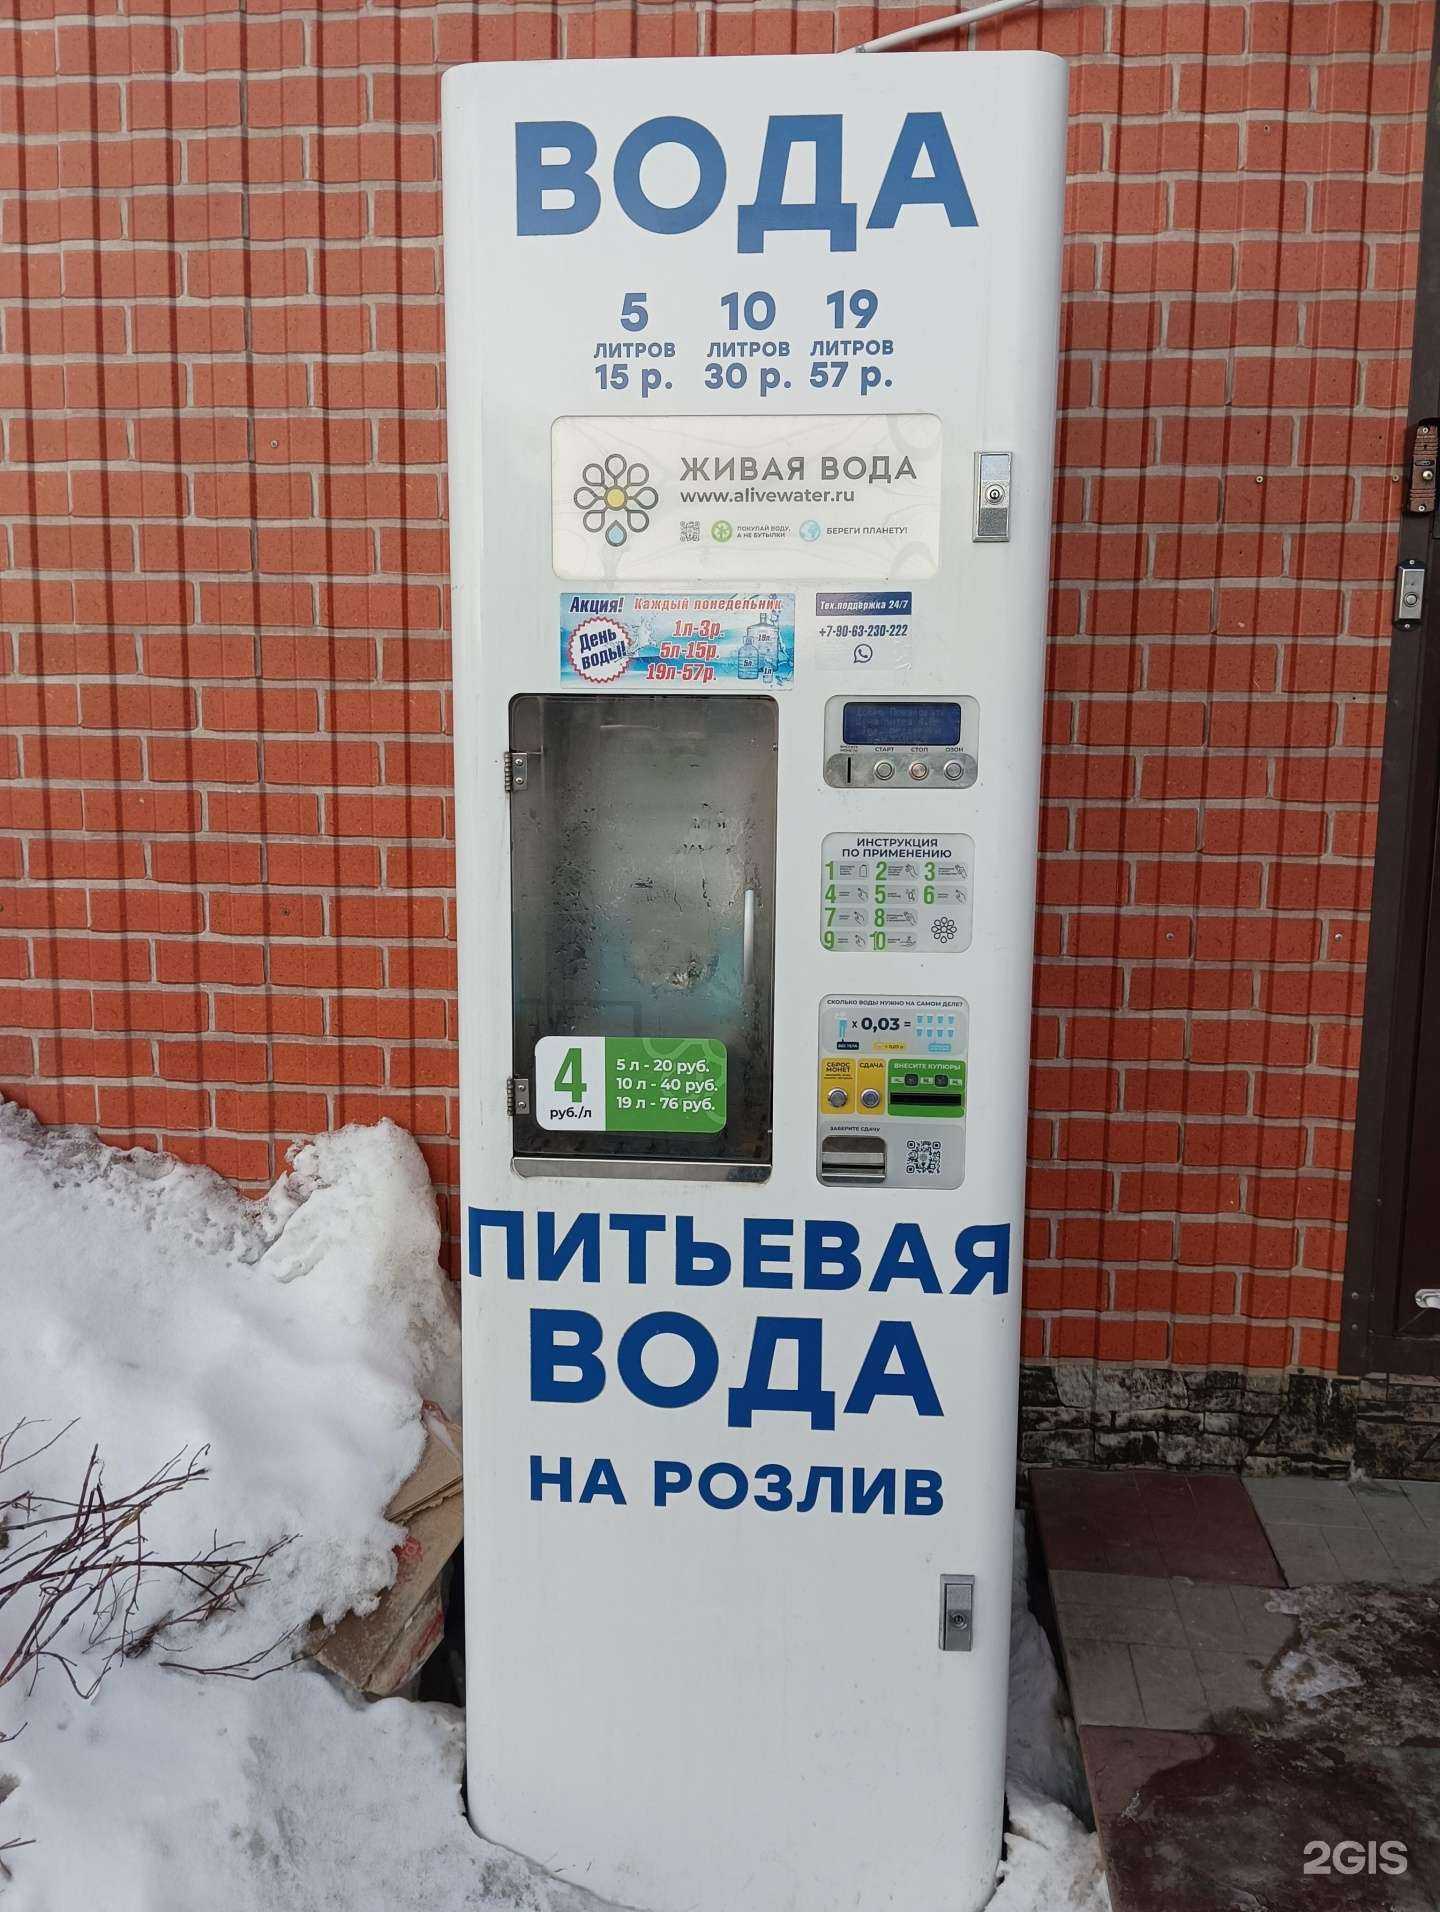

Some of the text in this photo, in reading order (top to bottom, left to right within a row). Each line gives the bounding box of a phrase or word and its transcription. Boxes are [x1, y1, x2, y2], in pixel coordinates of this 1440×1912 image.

[515, 112, 979, 254] ВОДА
[620, 289, 878, 332] 5 10 19
[593, 339, 894, 359] ЛИТРОВ ЛИТРОВ ЛИТРОВ
[595, 361, 893, 398] 15 р. 30 р. 57 р.
[680, 456, 917, 484] ЖИВАЯ ВОДА
[680, 487, 855, 503] www.alivewater.ru
[827, 526, 908, 535] БЕРЕГИ ПЛАНЕТУ!
[570, 597, 782, 614] Акция! Каждый понедельник
[821, 599, 909, 611] Тех.поддержка 24/7
[579, 627, 617, 652] День
[672, 620, 724, 640] 1л-3р.
[819, 624, 908, 638] +7-90-63-230-222
[581, 639, 627, 670] воды!
[660, 641, 720, 662] 5л-15р.
[646, 664, 717, 684] 19л-57р.
[857, 838, 938, 848] ИНСТРУКЦИЯ
[842, 848, 952, 858] ПО ПРИМЕНЕНИЮ
[825, 861, 834, 880] 1
[875, 861, 887, 881] 2
[924, 862, 935, 881] 3
[825, 884, 837, 904] 4
[875, 885, 886, 904] 5
[923, 885, 935, 904] 6
[825, 907, 836, 927] 7
[874, 908, 885, 927] 8
[824, 930, 835, 949] 9
[870, 930, 886, 950] 10
[861, 1017, 900, 1032] 0,03
[554, 1048, 587, 1103] 4
[616, 1059, 625, 1070] 5
[629, 1062, 640, 1071] л
[653, 1060, 672, 1071] 20
[677, 1059, 709, 1075] руб.
[617, 1078, 632, 1089] 10
[636, 1081, 646, 1090] л
[660, 1079, 680, 1090] 40
[685, 1078, 718, 1093] руб.
[550, 1107, 592, 1119] руб./л
[617, 1097, 632, 1108] 19
[636, 1100, 646, 1109] л
[660, 1098, 679, 1109] 76
[683, 1098, 715, 1113] руб.
[468, 1206, 1011, 1295] ПИТЬЕВАЯ
[530, 1308, 945, 1432] ВОДА
[530, 1455, 944, 1516] НА РОЗЛИВ
